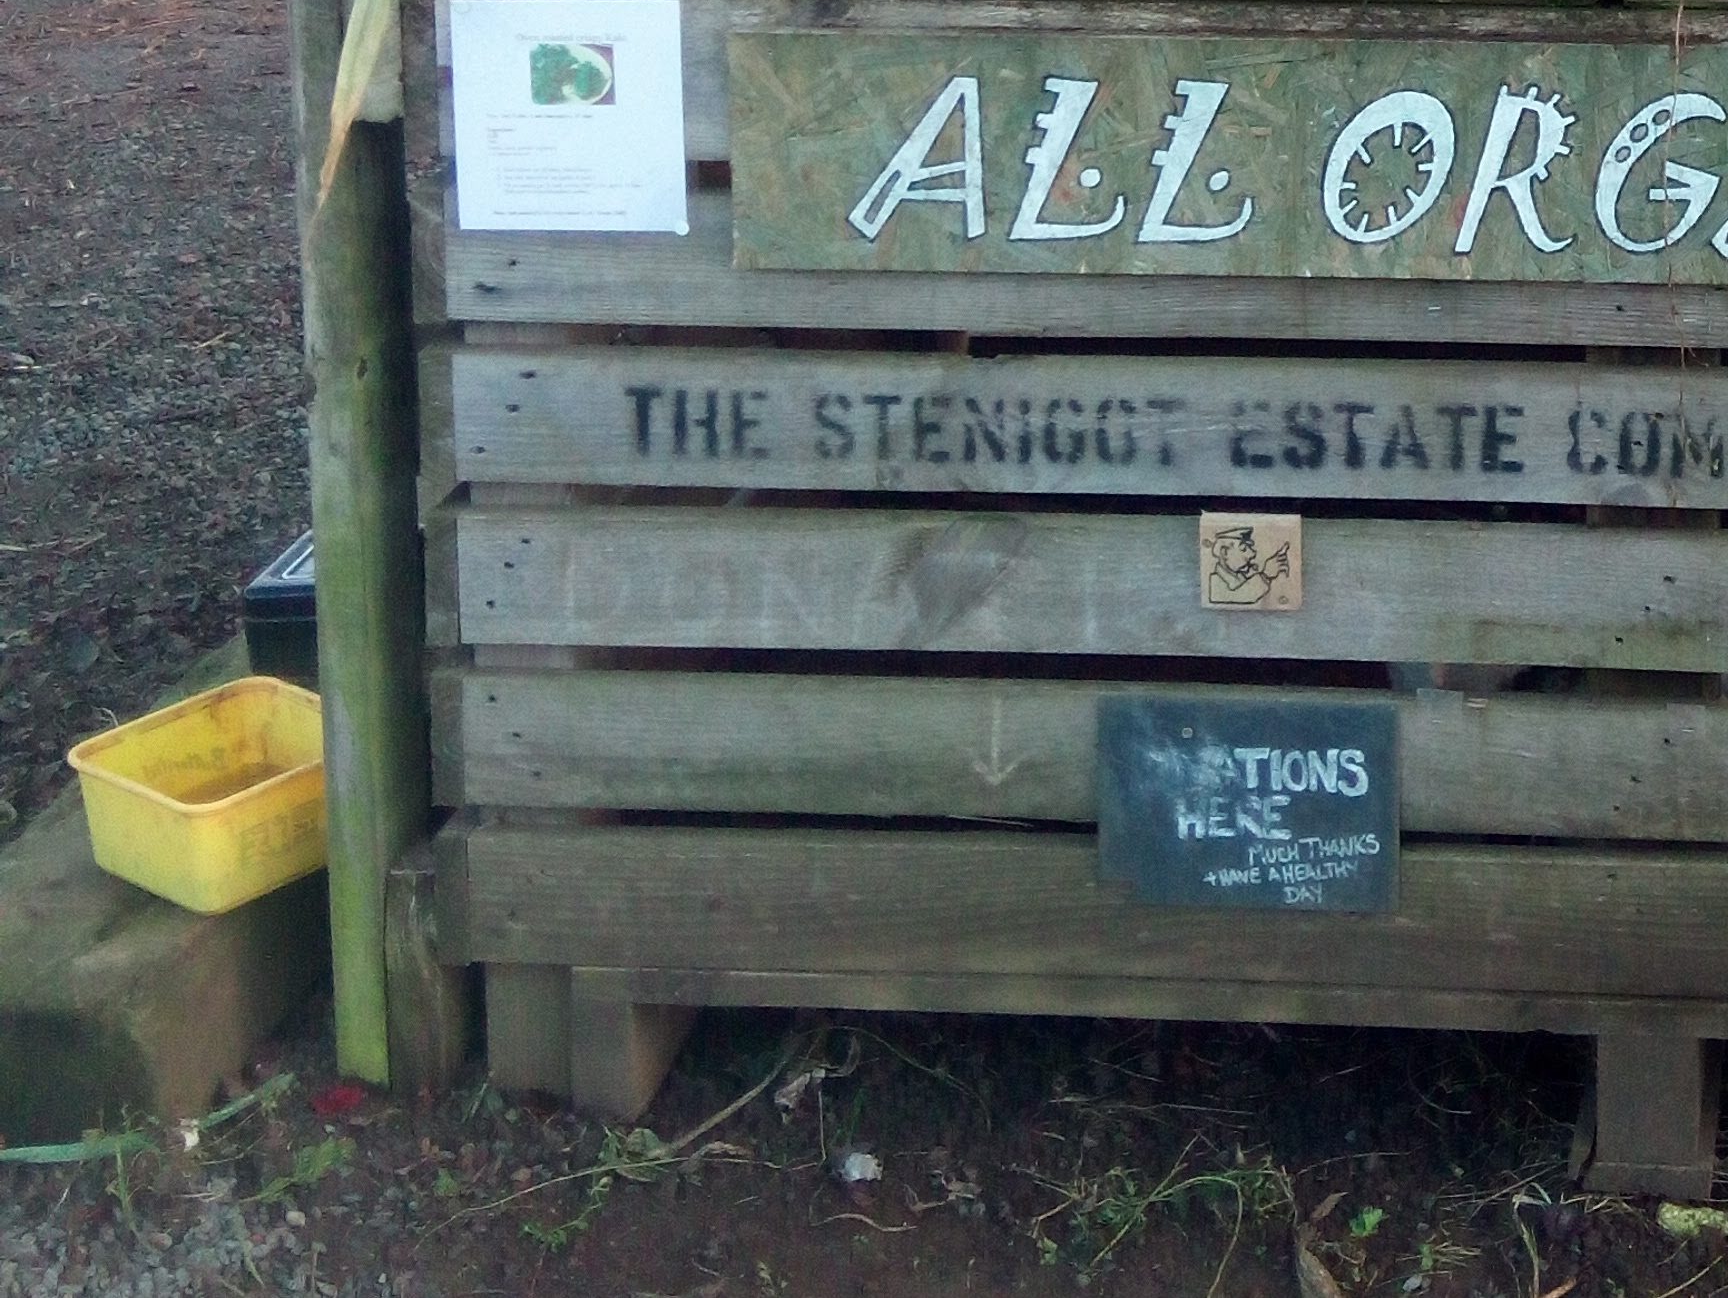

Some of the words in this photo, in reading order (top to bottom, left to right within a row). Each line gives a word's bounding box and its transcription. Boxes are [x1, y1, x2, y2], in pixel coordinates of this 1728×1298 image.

[848, 73, 1255, 247] ALL
[624, 385, 770, 460] THE
[1229, 401, 1526, 473] ESTATE
[1176, 793, 1293, 841] HERE
[1248, 843, 1301, 867] MUCH
[1298, 832, 1381, 860] THANKS
[1282, 883, 1326, 905] DAY
